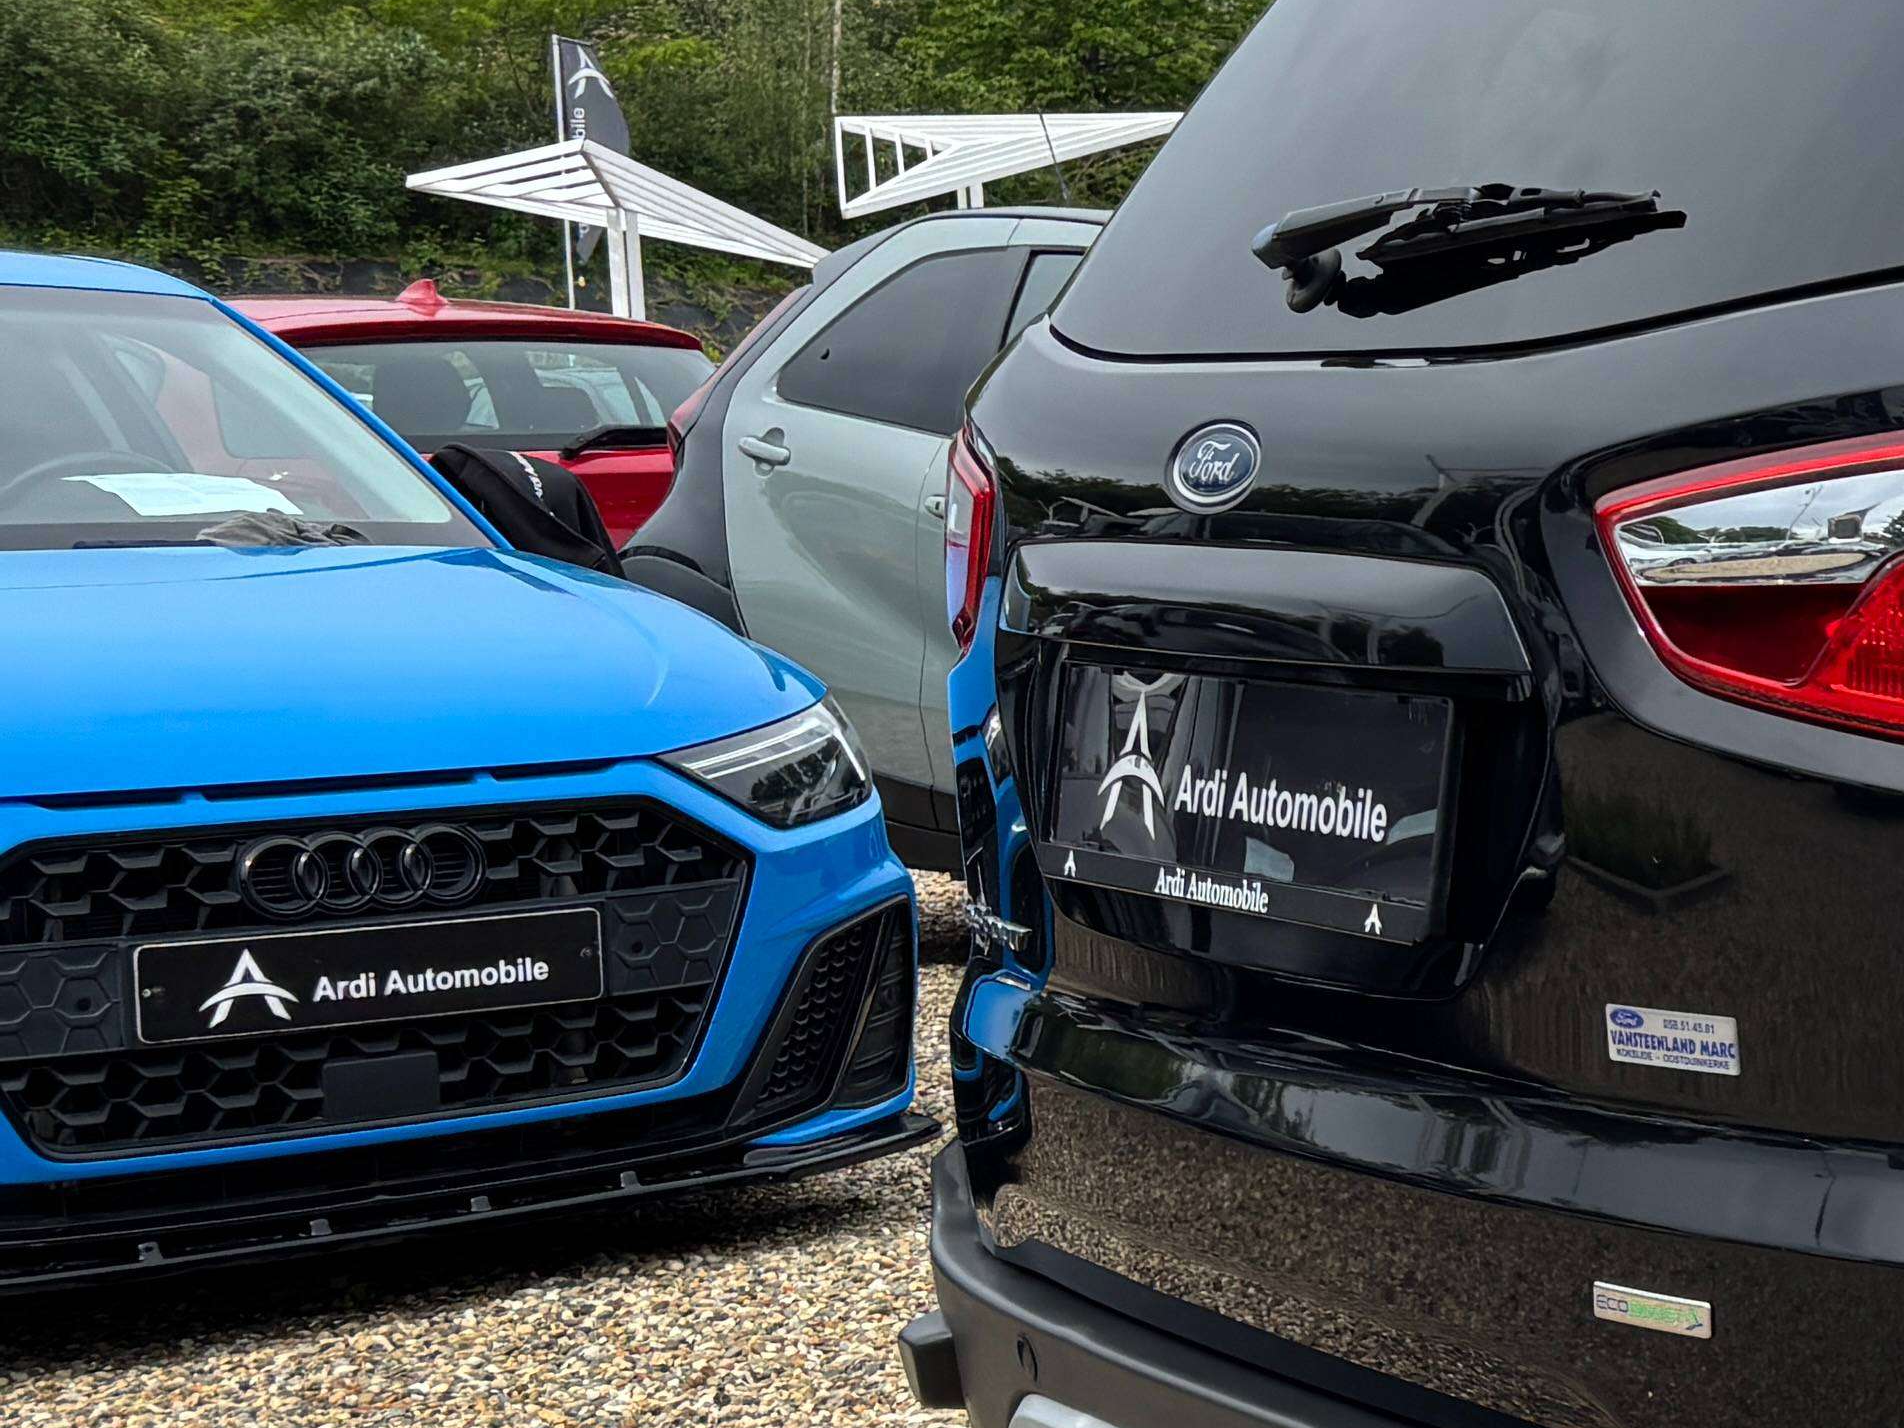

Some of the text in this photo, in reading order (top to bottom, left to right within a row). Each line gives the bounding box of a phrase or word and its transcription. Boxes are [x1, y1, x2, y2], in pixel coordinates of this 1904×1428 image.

[1188, 440, 1240, 482] Ford
[1174, 765, 1228, 819] Ardi
[1229, 772, 1388, 843] Automobile
[1154, 867, 1185, 899] Ardi
[1186, 872, 1269, 915] Automobile
[312, 972, 376, 1002] Ardi
[384, 957, 550, 996] Automobile
[1699, 1039, 1736, 1059] MARC
